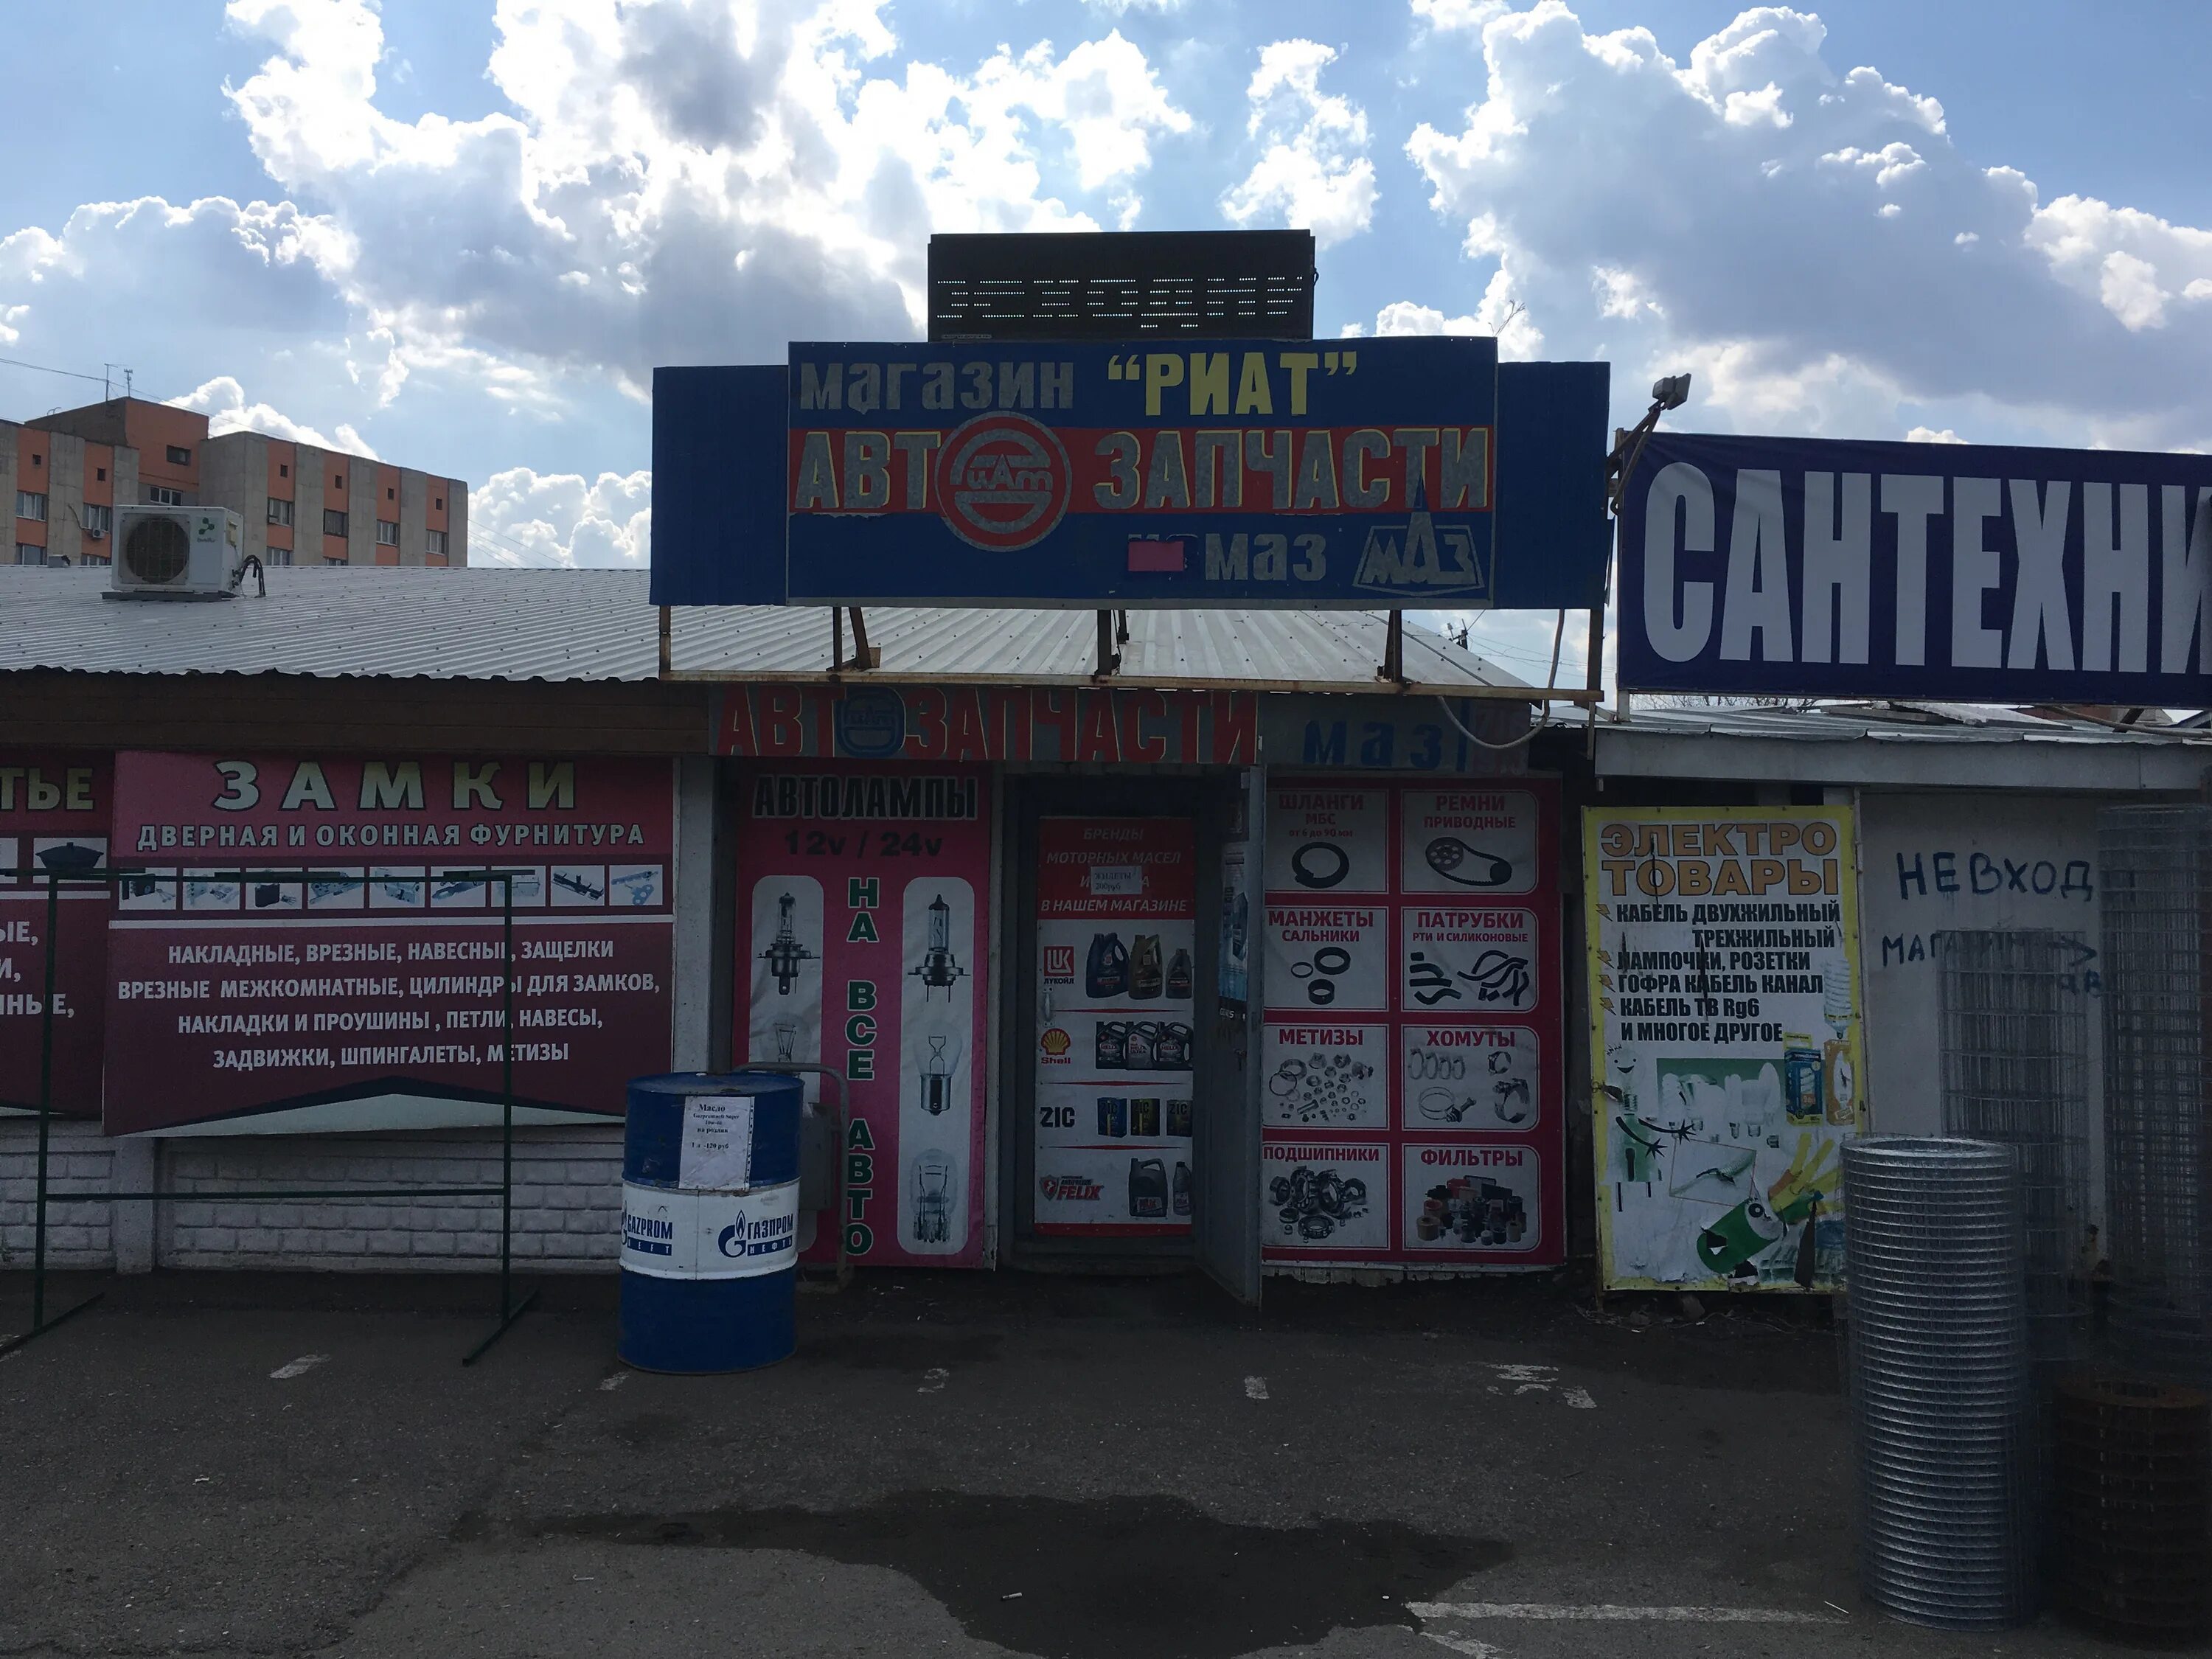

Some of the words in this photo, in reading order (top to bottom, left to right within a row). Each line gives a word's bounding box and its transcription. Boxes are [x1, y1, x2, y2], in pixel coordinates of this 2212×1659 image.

[1093, 428, 1489, 509] ЗАПЧАСТИ
[1643, 461, 2212, 675] САНТЕХНИ
[211, 759, 577, 811] ЗАМКИ
[752, 774, 978, 821] АВТОЛАМПЫ
[1279, 794, 1364, 810] ШЛАНГИ
[1436, 796, 1506, 811] РЕМНИ
[1305, 813, 1336, 825] МБС
[1424, 816, 1517, 830] ПРИВОДНЫЕ
[136, 824, 279, 852] ДВЕРНАЯ
[288, 824, 306, 847] И
[315, 824, 461, 847] ОКОННАЯ
[469, 822, 645, 849] ФУРНИТУРА
[1082, 827, 1144, 841] БРЕНДЫ
[1601, 822, 1837, 858] ЭЛЕКТРО
[1046, 852, 1129, 865] МОТОРНЫХ
[1132, 851, 1183, 865] МАСЕЛ
[1601, 859, 1839, 897] ТОВАРЫ
[846, 877, 880, 943] НА
[1040, 900, 1051, 912] В
[1053, 900, 1108, 912] НАШЕМ
[1110, 900, 1187, 912] МАГАЗИНЕ
[1616, 903, 1688, 922] КАБЕЛЬ
[1691, 900, 1841, 925] ДВУХЖИЛЬНЫЙ
[1267, 911, 1374, 928] МАНЖЕТЫ
[1417, 912, 1524, 929] ПАТРУБКИ
[1281, 930, 1360, 942] САЛЬНИКИ
[1413, 932, 1433, 942] РТИ
[1437, 933, 1444, 942] И
[1446, 932, 1528, 943] СИЛИКОНОВЫЕ
[1691, 925, 1835, 948] ТРЕХЖИЛЬНЫЙ
[168, 945, 301, 967] НАКЛАДНЫЕ,
[306, 943, 403, 964] ВРЕЗНЫЕ,
[521, 940, 614, 962] ЗАЩЕЛКИ
[1730, 951, 1811, 971] РОЗЕТКИ
[118, 980, 210, 1000] ВРЕЗНЫЕ
[220, 977, 405, 998] МЕЖКОМНАТНЫЕ,
[527, 975, 568, 996] ДЛЯ
[573, 973, 660, 994] ЗАМКОВ,
[1043, 976, 1074, 985] ЛУКОЙЛ
[1618, 975, 1681, 993] ГОФРА
[1684, 974, 1757, 994] КАБЕЛЬ
[1761, 974, 1823, 994] КАНАЛ
[1620, 998, 1691, 1017] КАБЕЛЬ
[1694, 998, 1719, 1017] ТВ
[1723, 998, 1760, 1019] Rg6
[178, 1014, 289, 1036] НАКЛАДКИ
[294, 1014, 308, 1032] И
[519, 1008, 603, 1029] НАВЕСЫ,
[844, 980, 877, 1081] ВСЕ
[1279, 1029, 1363, 1046] МЕТИЗЫ
[1427, 1030, 1516, 1047] ХОМУТЫ
[1621, 1023, 1633, 1042] И
[1637, 1023, 1711, 1042] МНОГОЕ
[1714, 1022, 1784, 1044] ДРУГОЕ
[212, 1048, 335, 1071] ЗАДВИЖКИ,
[341, 1044, 482, 1066] ШПИНГАЛЕТЫ,
[1041, 1057, 1071, 1065] Shell
[698, 1104, 726, 1112] Масло
[1040, 1107, 1075, 1128] ZIC
[1263, 1147, 1380, 1162] ПОДШИПНИКИ
[1421, 1148, 1523, 1166] ФИЛЬТРЫ
[1057, 1185, 1104, 1200] FELIX
[627, 1214, 672, 1239] GAZPROM
[748, 1214, 793, 1239] ГАЗПРОМ
